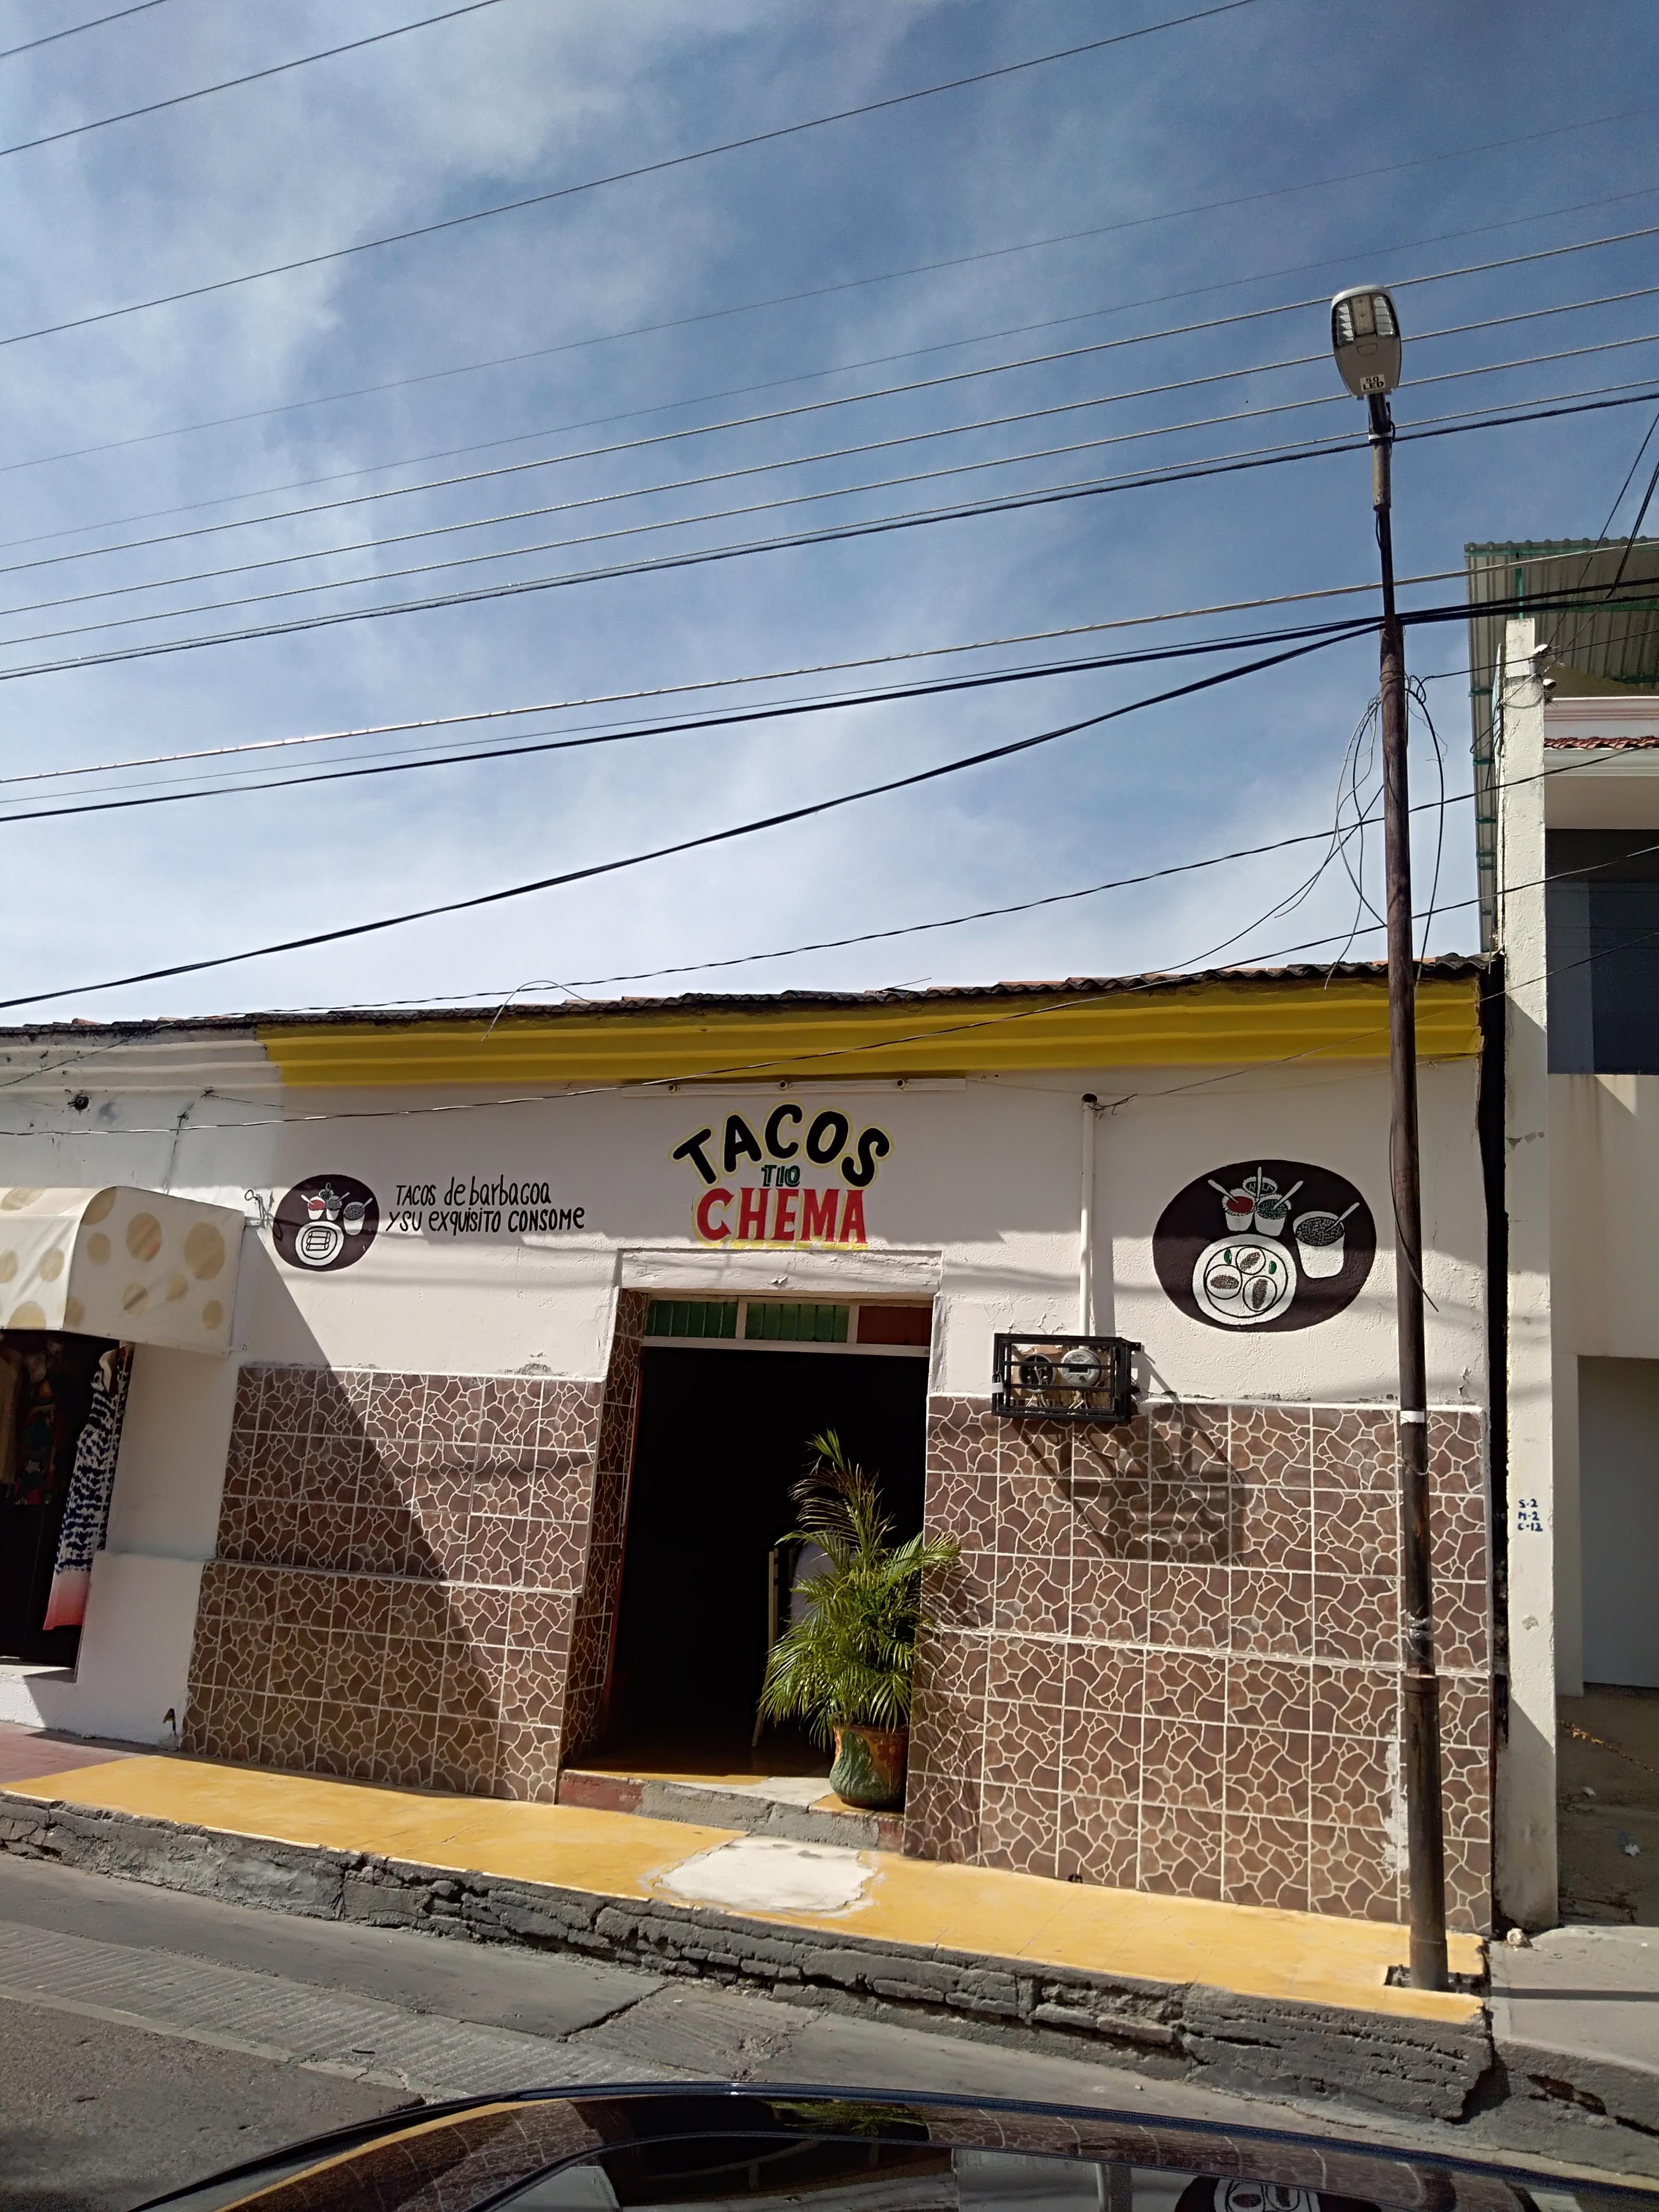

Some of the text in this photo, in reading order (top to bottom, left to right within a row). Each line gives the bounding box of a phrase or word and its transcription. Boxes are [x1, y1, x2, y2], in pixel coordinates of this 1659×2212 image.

[1363, 381, 1384, 390] LED
[672, 1104, 890, 1187] TACOS
[396, 1174, 552, 1206] TACOS de barbacoa
[761, 1164, 801, 1187] TIO
[697, 1187, 867, 1244] CHEMA
